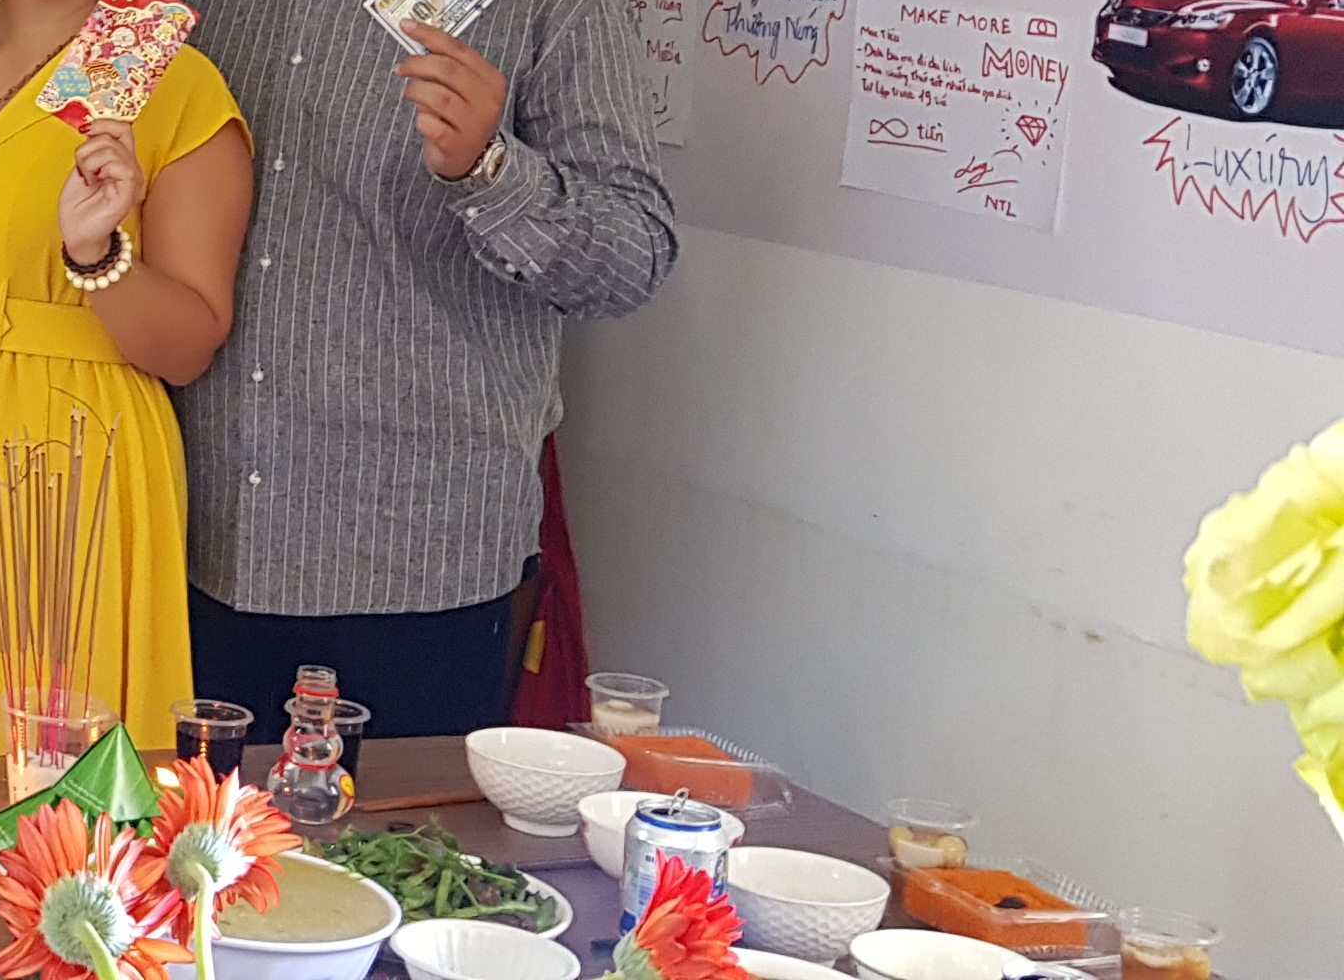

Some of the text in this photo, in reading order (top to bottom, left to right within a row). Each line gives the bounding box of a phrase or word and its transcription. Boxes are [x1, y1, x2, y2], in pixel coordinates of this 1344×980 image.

[900, 4, 1012, 35] MAKE MORE
[981, 41, 1070, 107] MONEY
